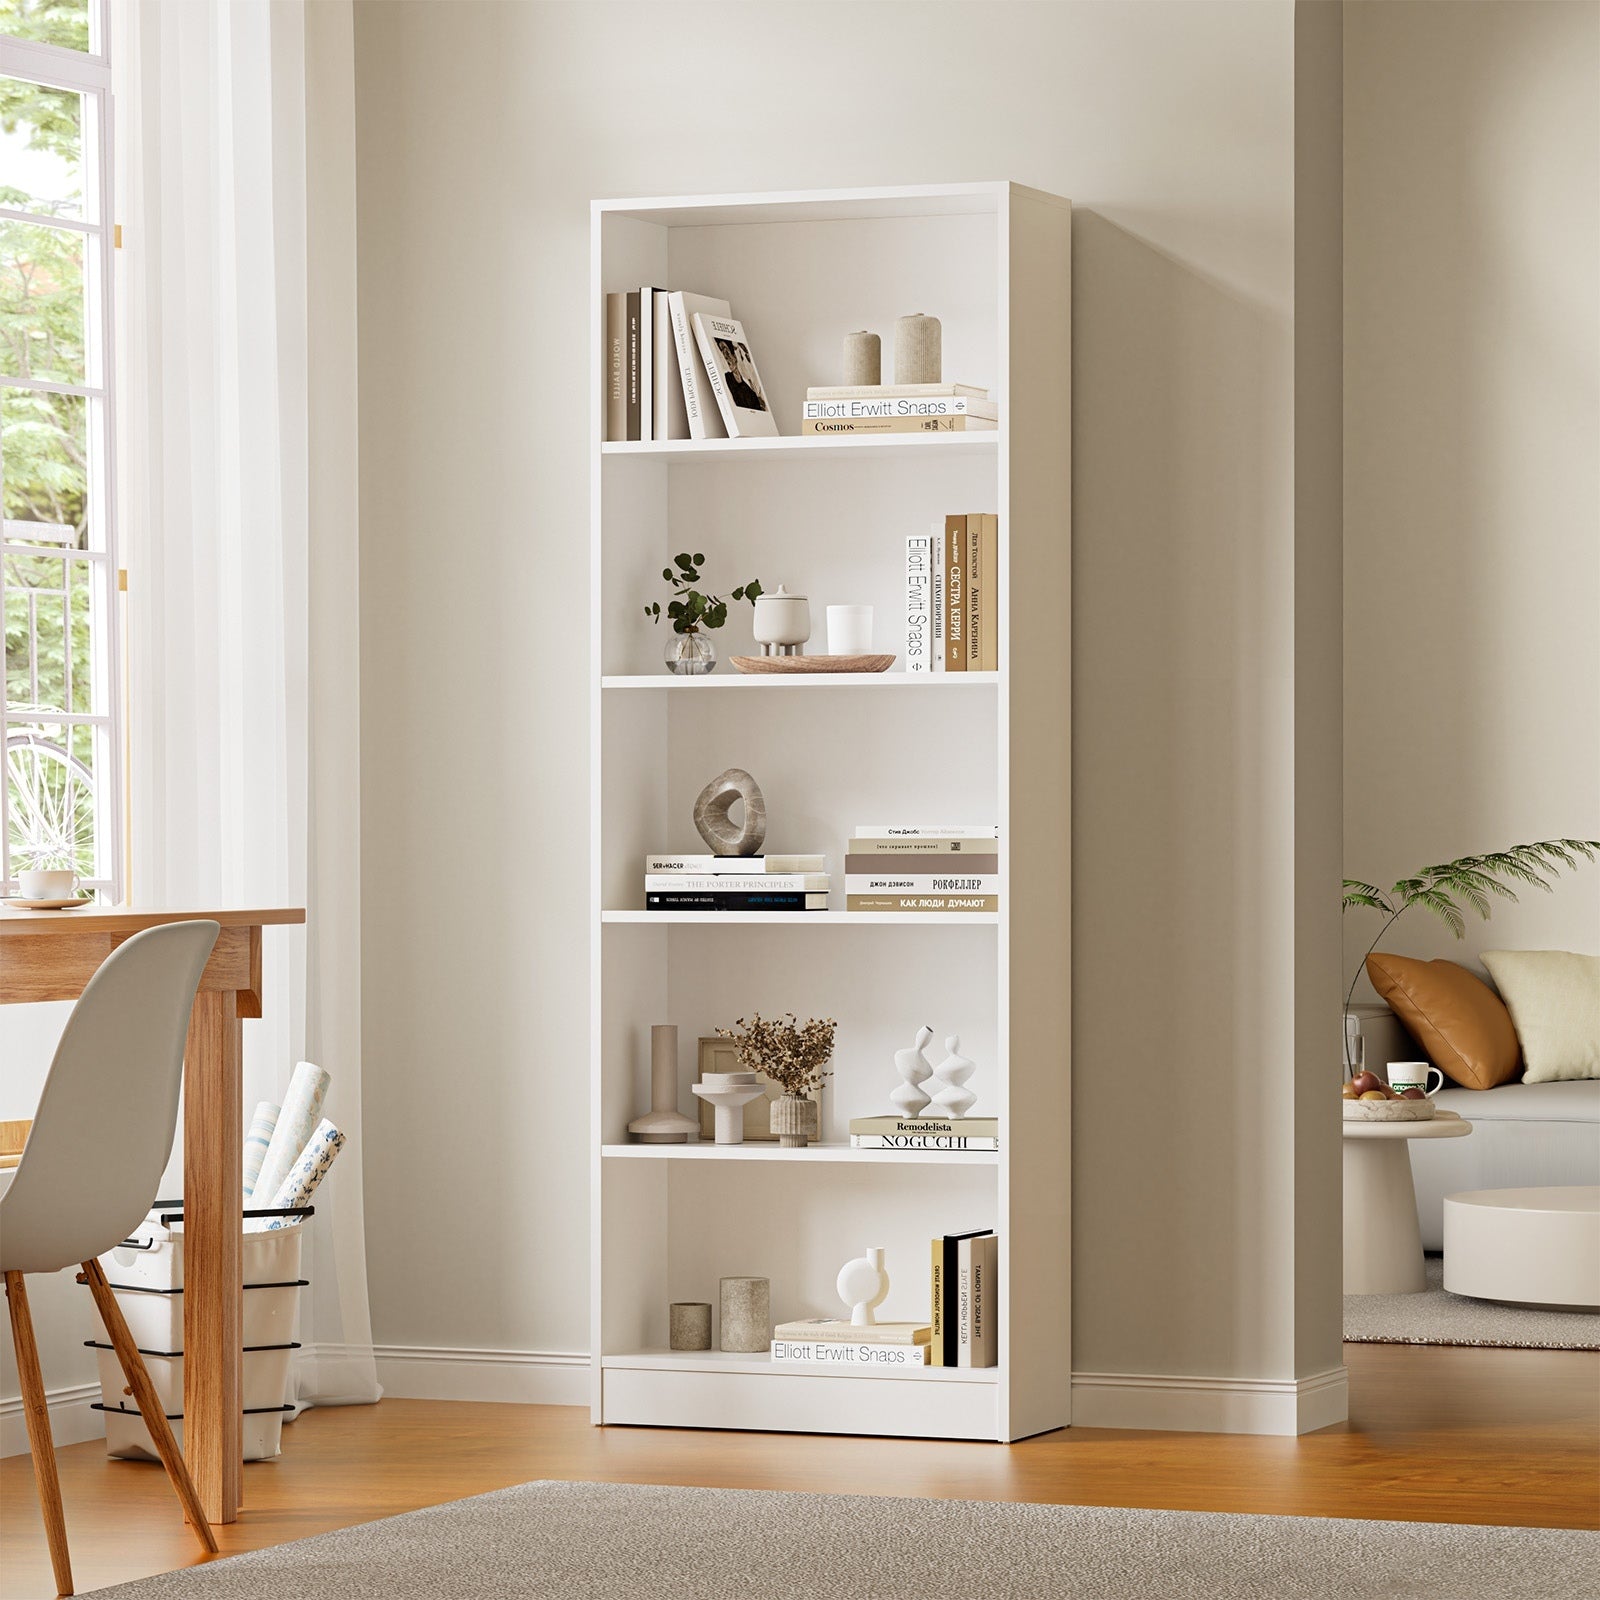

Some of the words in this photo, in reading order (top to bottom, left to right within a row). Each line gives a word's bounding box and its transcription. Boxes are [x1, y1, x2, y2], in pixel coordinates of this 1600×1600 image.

[808, 402, 846, 418] Elliott
[851, 401, 894, 416] Erwitt
[898, 400, 947, 416] Snaps
[814, 422, 854, 432] Cosmos
[908, 538, 926, 572] Elliott
[908, 576, 926, 611] Erwitt
[950, 566, 961, 606] СЕСТРА
[950, 608, 961, 641] КЕРРИ
[906, 615, 927, 656] Snaps
[932, 879, 982, 890] РОКФЕЛЛЕР
[900, 900, 916, 908] КАК
[918, 900, 944, 908] ЛЮДИ
[948, 900, 986, 908] ДУМАЮТ
[897, 1122, 952, 1132] Remodelista
[882, 1136, 968, 1148] NOGUCHI
[774, 1343, 811, 1360] Elliott
[816, 1344, 854, 1361] Erwitt
[859, 1346, 905, 1364] Snaps
